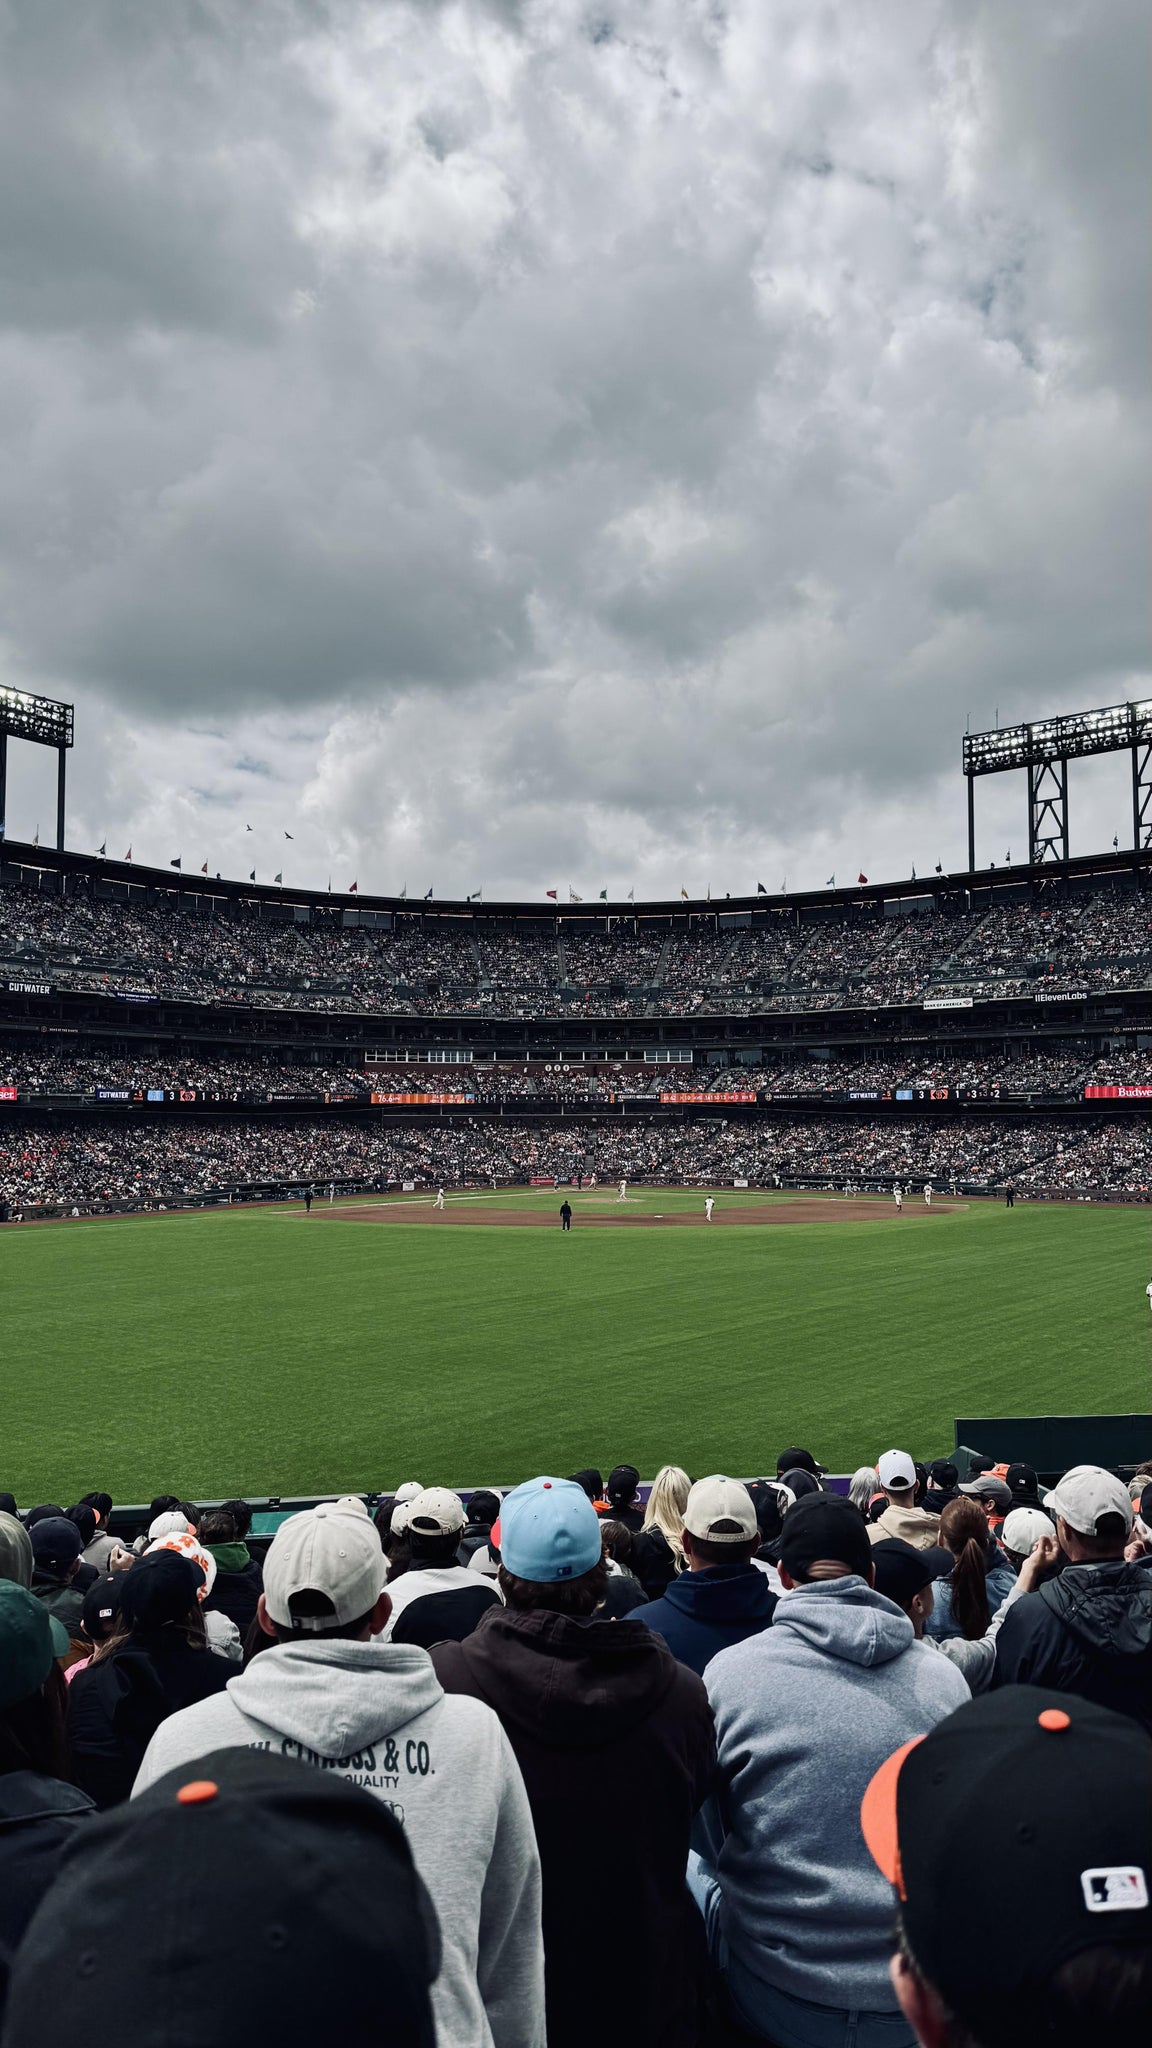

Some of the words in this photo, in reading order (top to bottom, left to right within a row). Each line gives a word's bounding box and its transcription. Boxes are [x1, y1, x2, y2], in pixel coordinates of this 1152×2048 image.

[9, 983, 50, 994] CUTWATER
[170, 1092, 175, 1100] 3
[202, 1092, 206, 1100] 1
[215, 1092, 220, 1100] 3
[233, 1093, 238, 1101] 2
[919, 1091, 924, 1099] 3
[955, 1090, 960, 1098] 1
[971, 1090, 977, 1098] 3
[994, 1090, 1000, 1098] 2
[1118, 1087, 1152, 1097] Budwe
[384, 1738, 399, 1773] &
[406, 1740, 435, 1776] CO.
